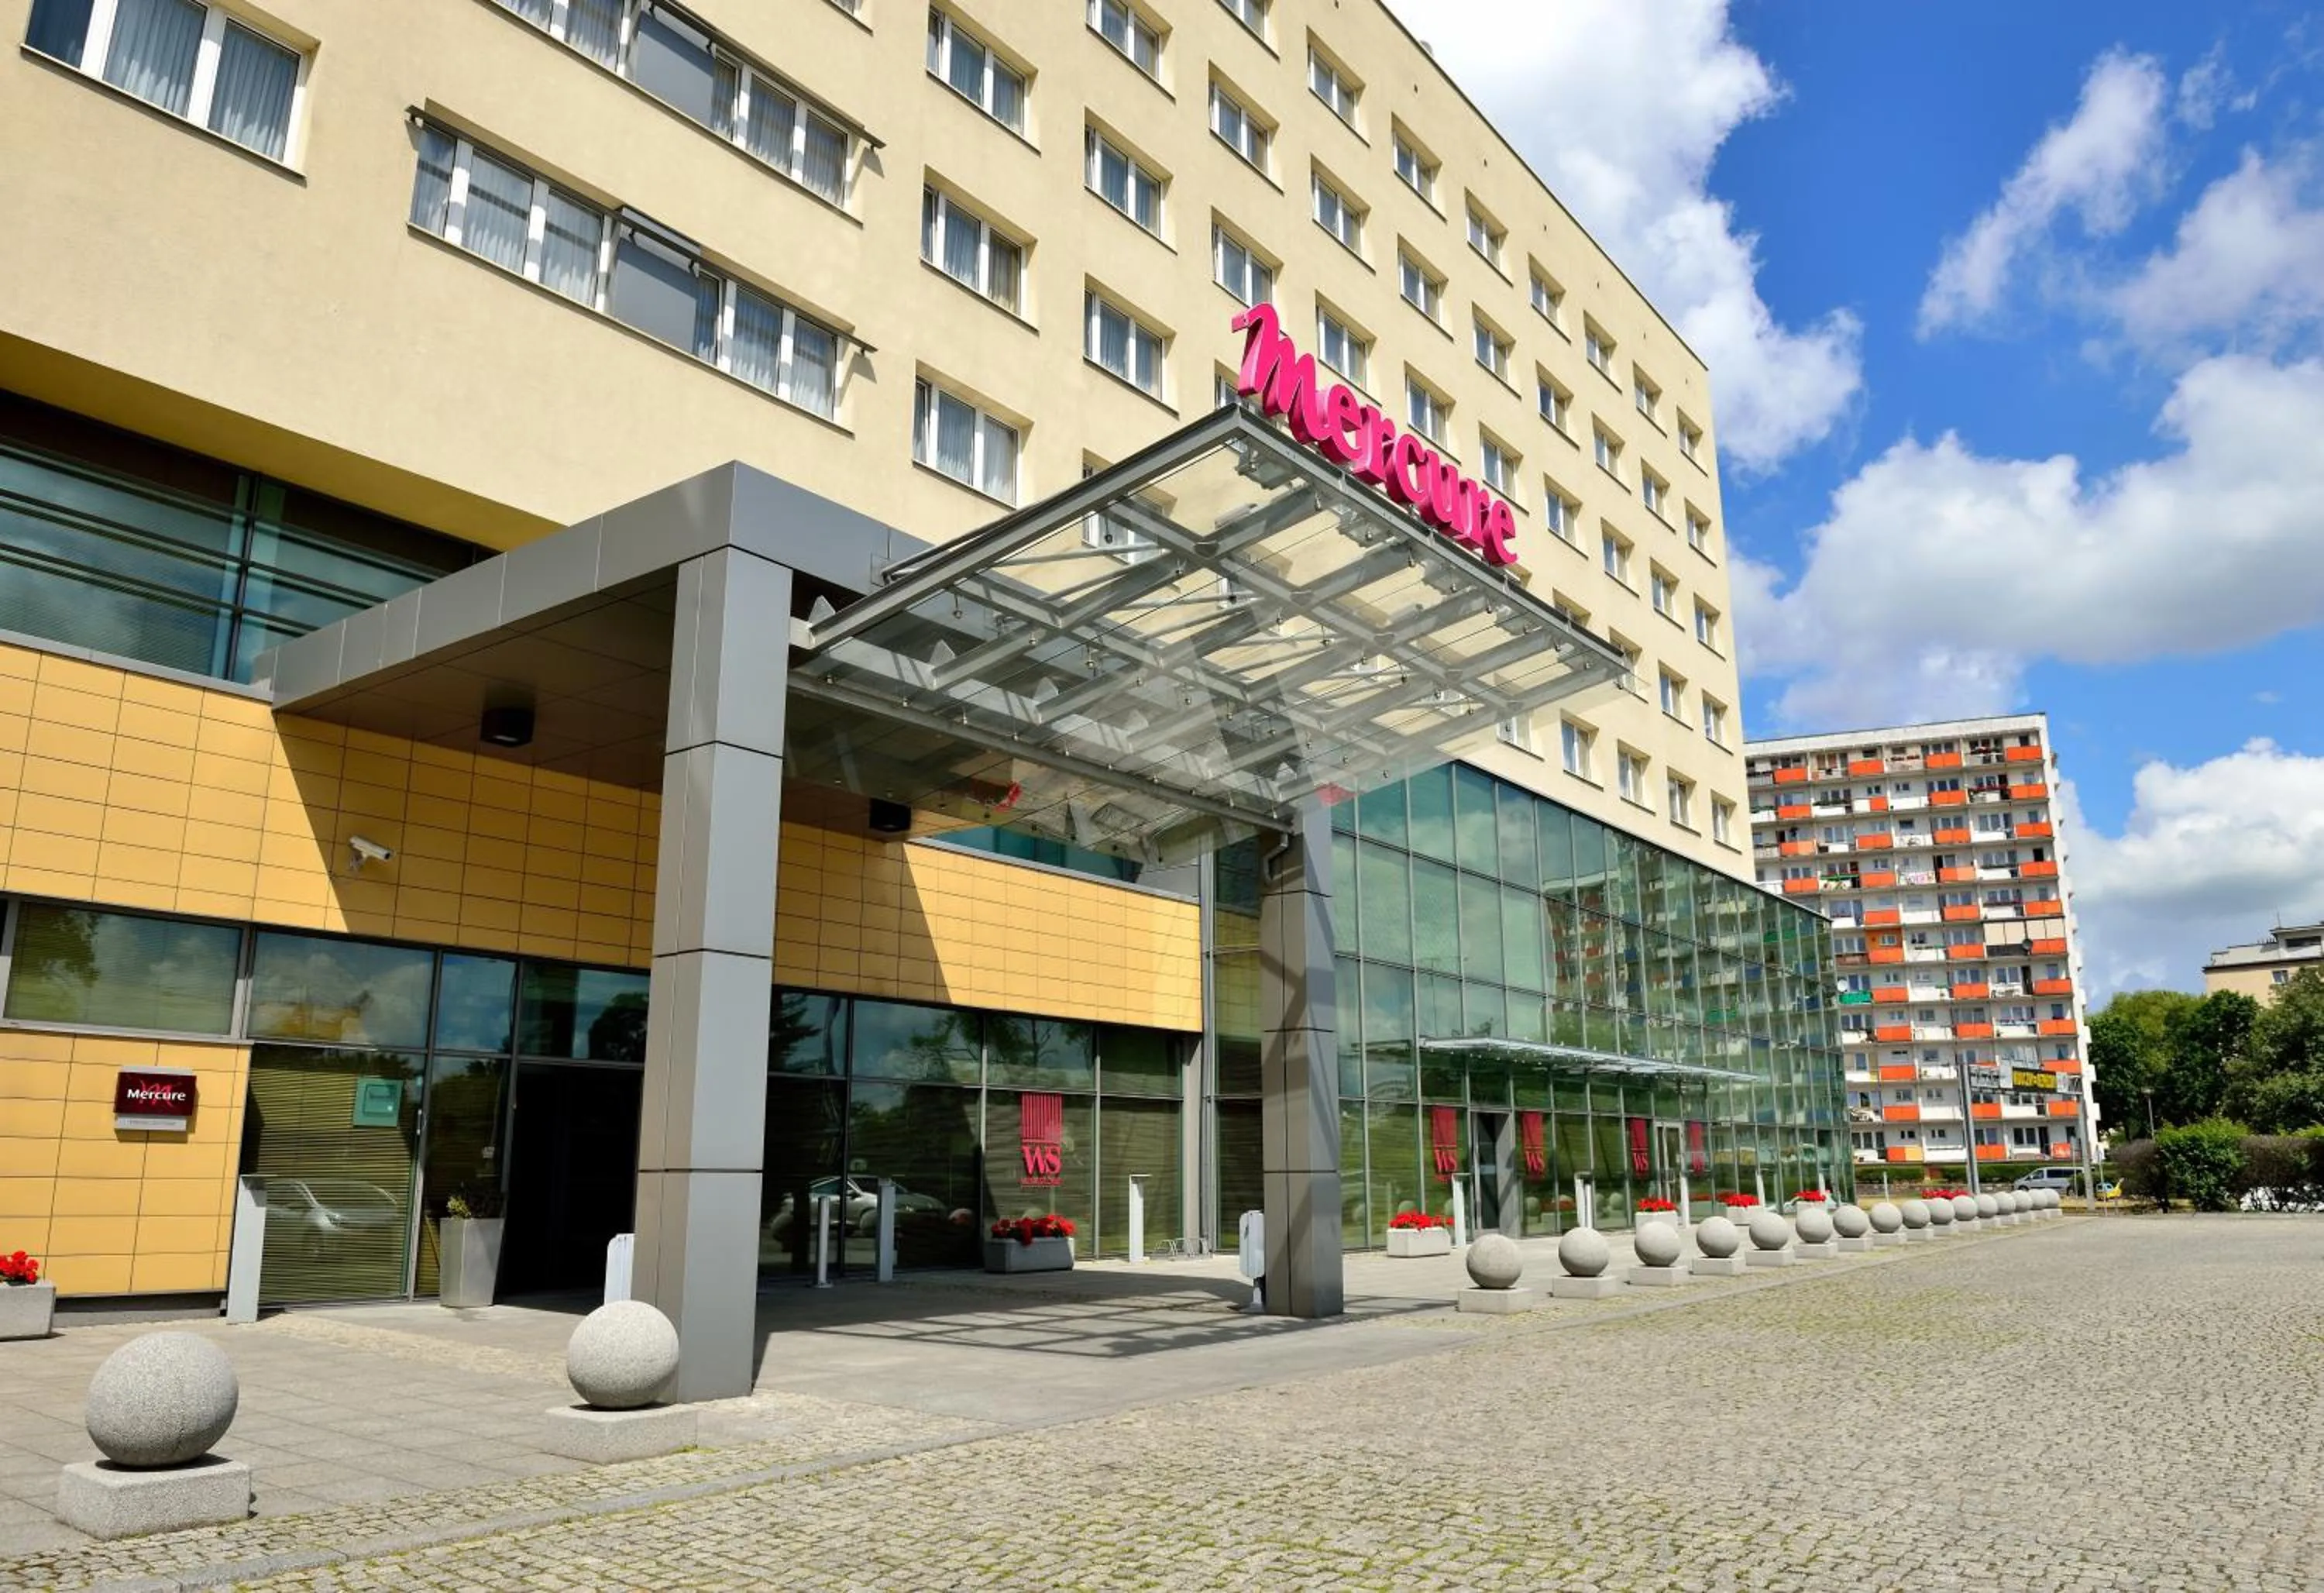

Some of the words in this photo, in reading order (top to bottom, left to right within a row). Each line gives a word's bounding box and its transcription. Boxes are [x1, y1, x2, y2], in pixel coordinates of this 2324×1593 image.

[1231, 301, 1518, 567] Mercure
[126, 1088, 186, 1101] Mercure
[1022, 1145, 1063, 1175] WS
